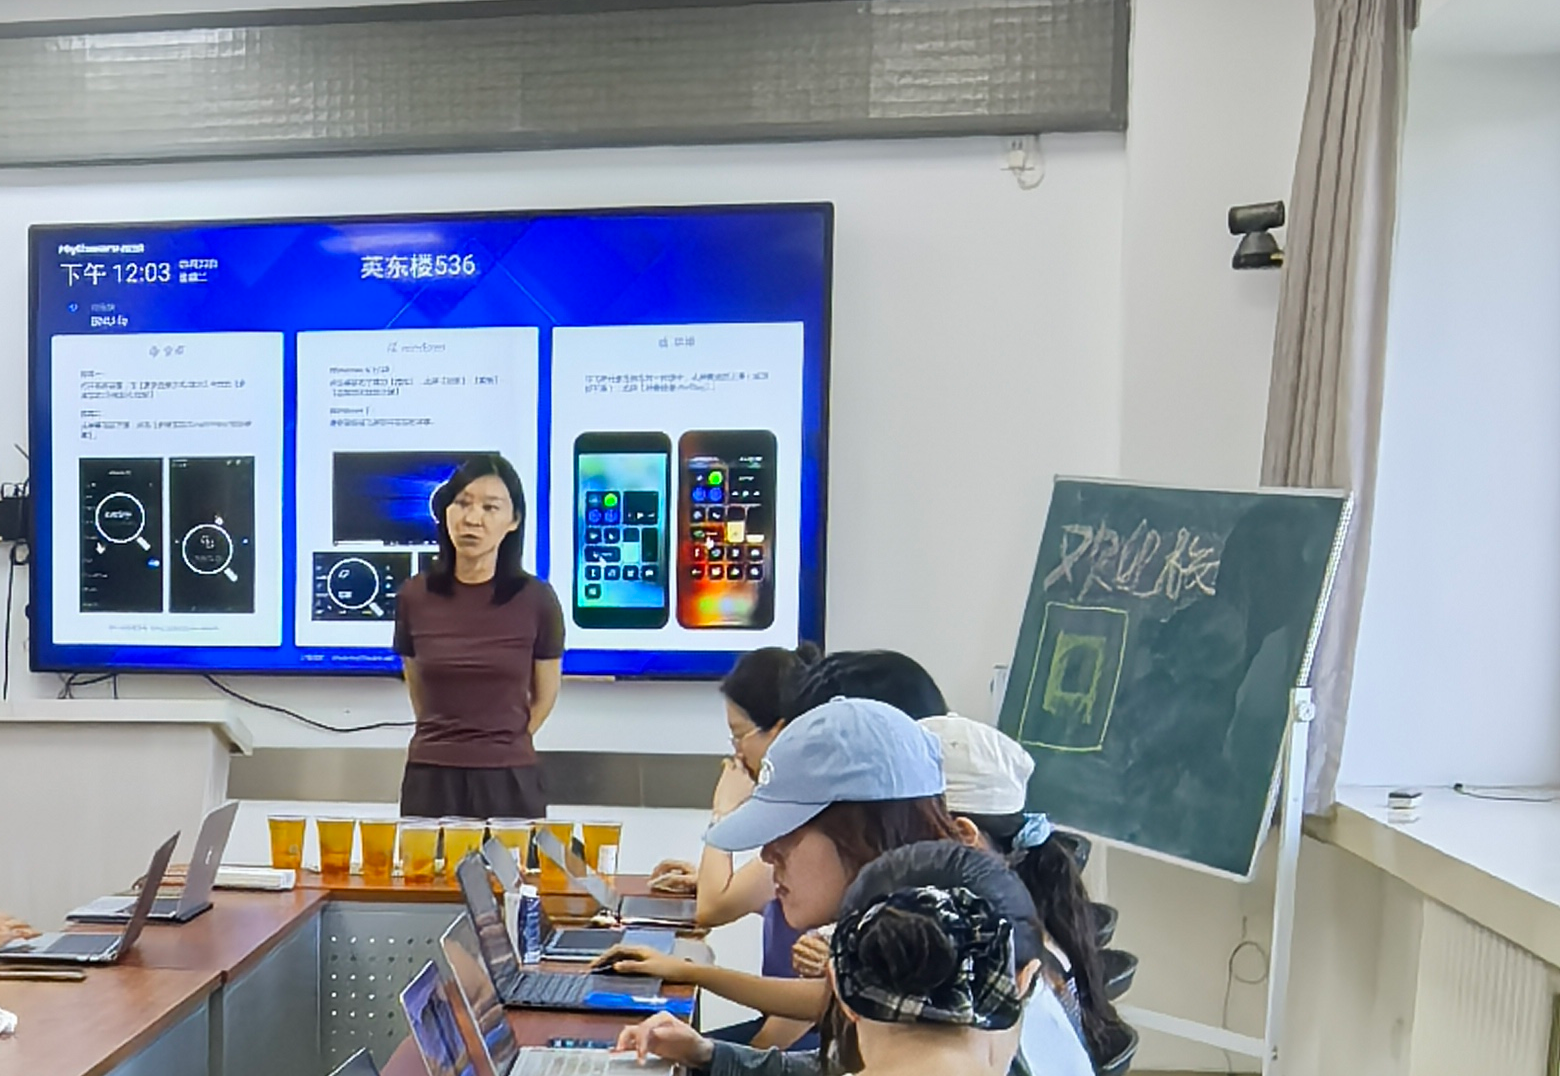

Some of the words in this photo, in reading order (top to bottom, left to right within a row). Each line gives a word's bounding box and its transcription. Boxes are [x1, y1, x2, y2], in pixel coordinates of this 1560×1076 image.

[60, 262, 107, 287] 下午
[112, 262, 171, 284] 12:03
[360, 253, 476, 280] 英东楼536
